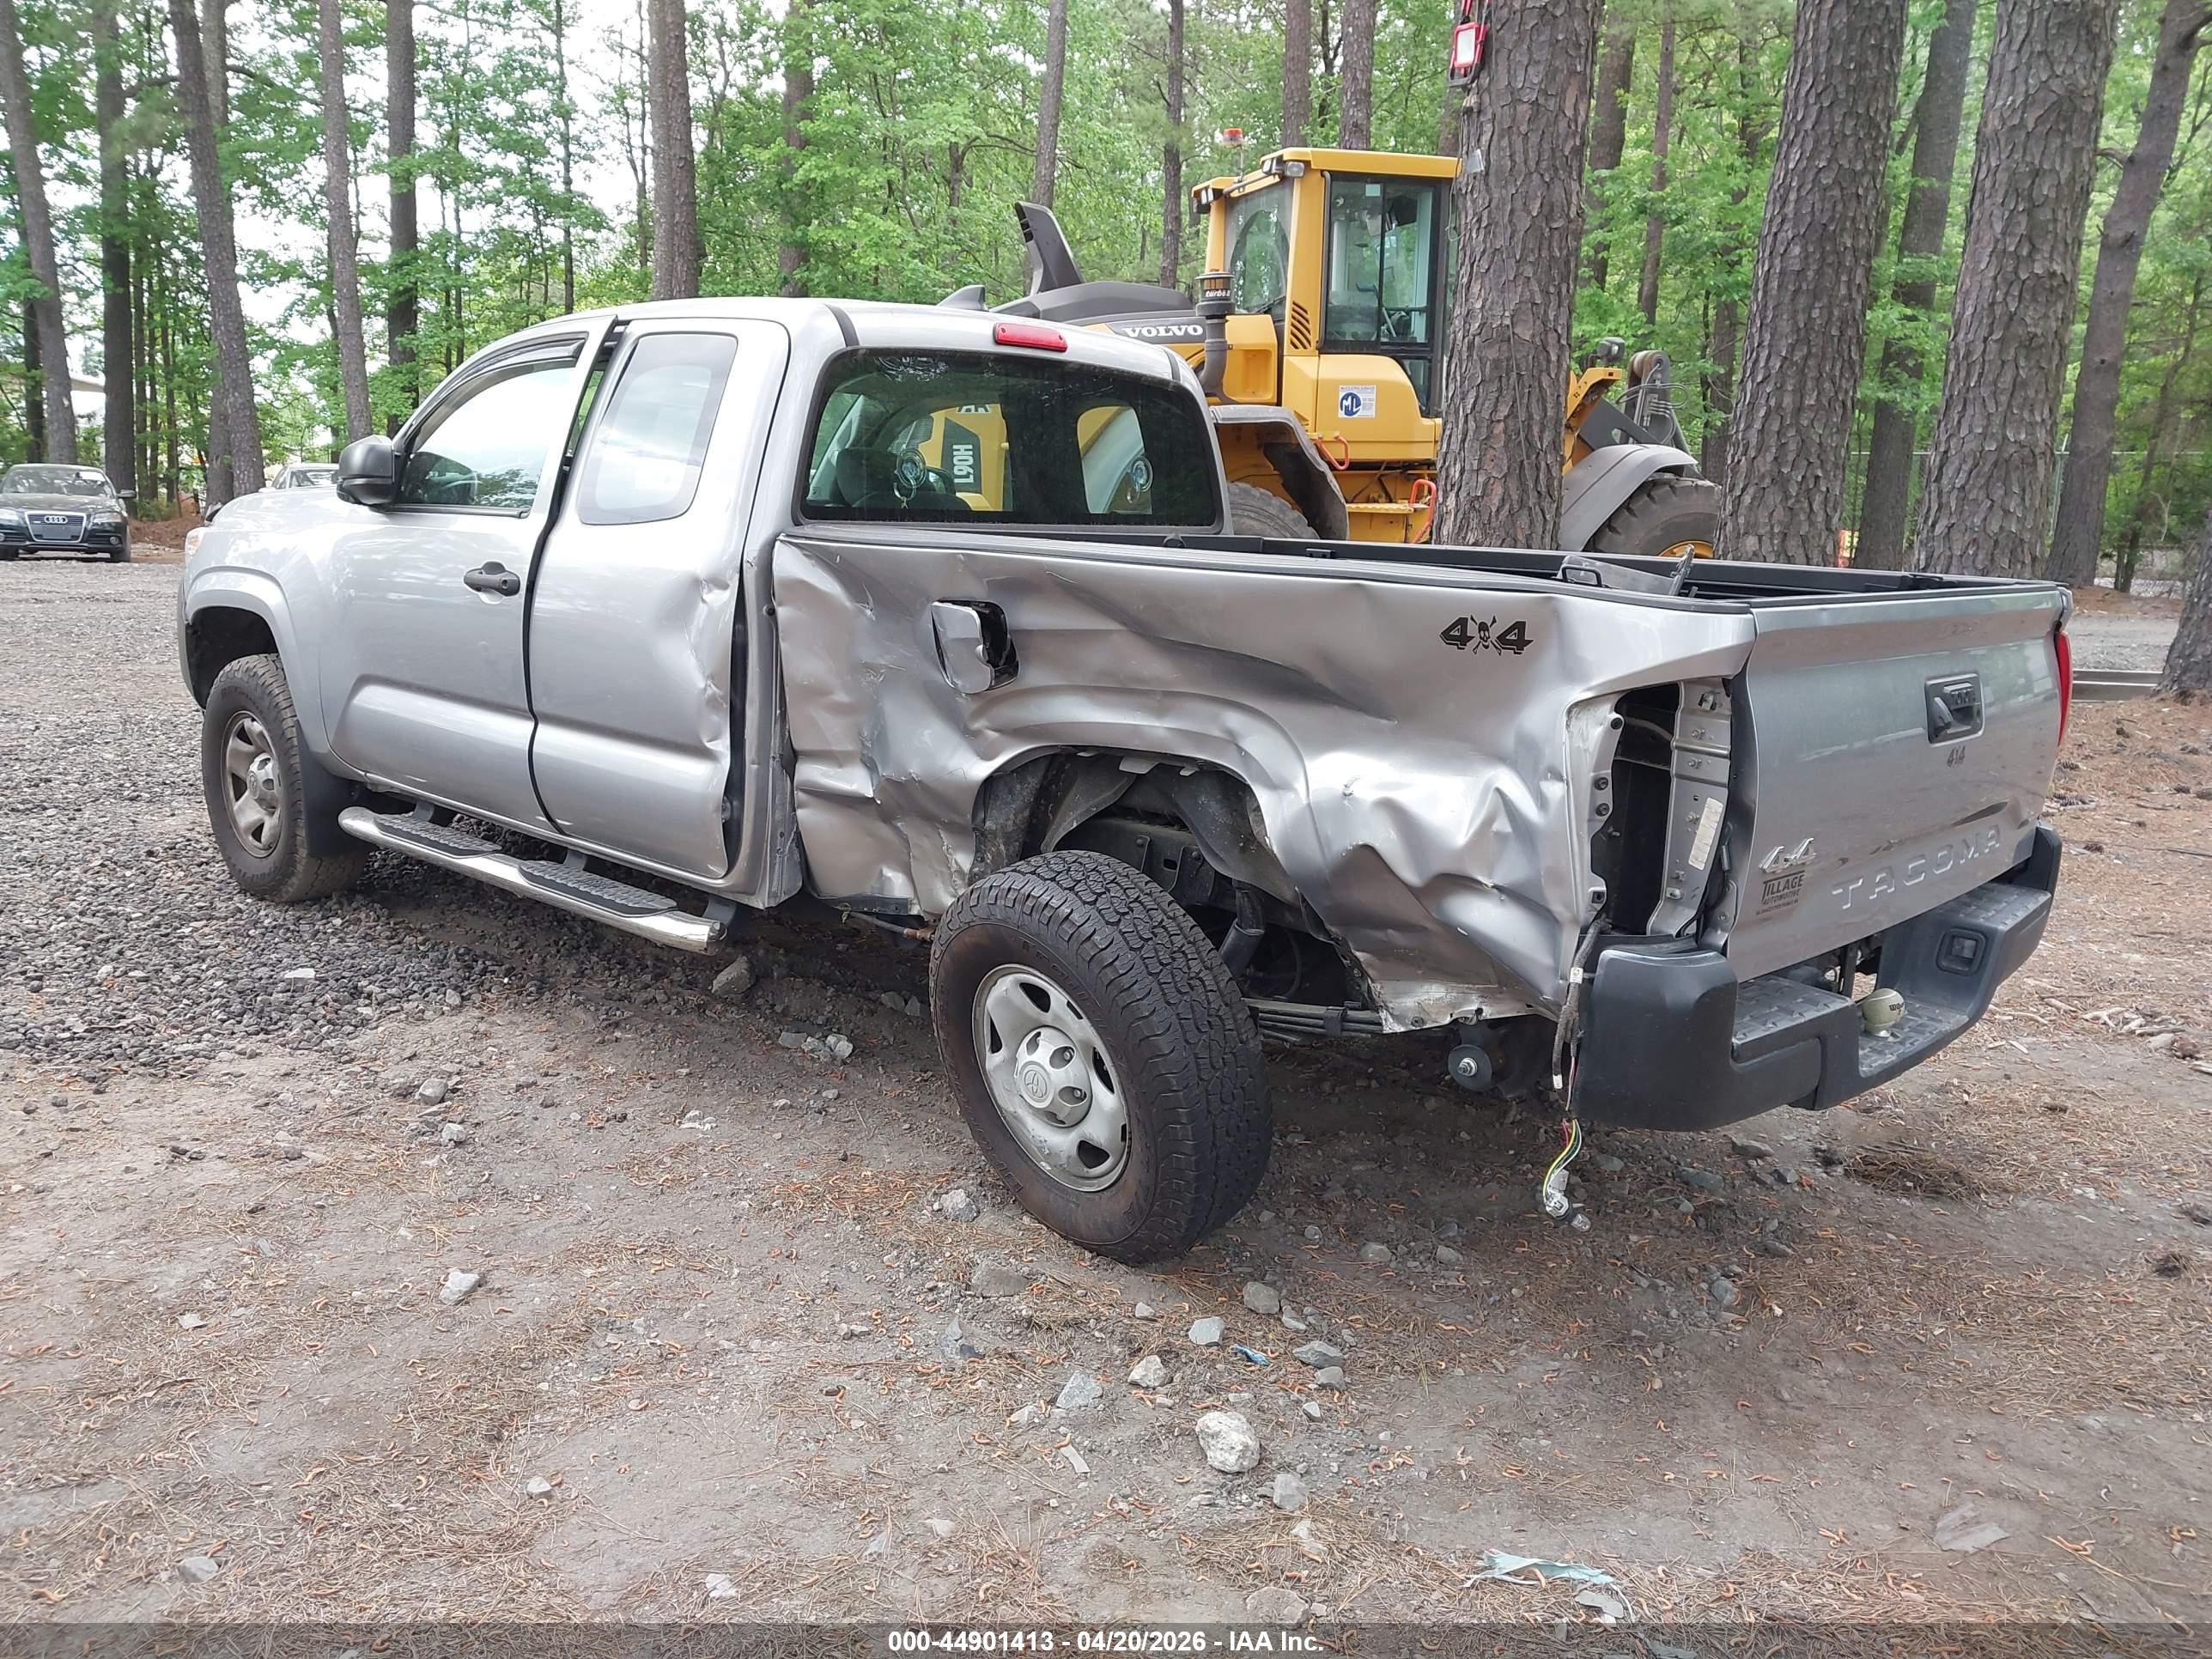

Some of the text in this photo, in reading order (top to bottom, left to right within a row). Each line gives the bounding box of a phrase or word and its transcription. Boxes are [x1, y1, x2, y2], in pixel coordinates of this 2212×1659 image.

[1122, 325, 1204, 337] VOLVO
[952, 444, 975, 483] L90H
[1831, 824, 2002, 910] TACOMA
